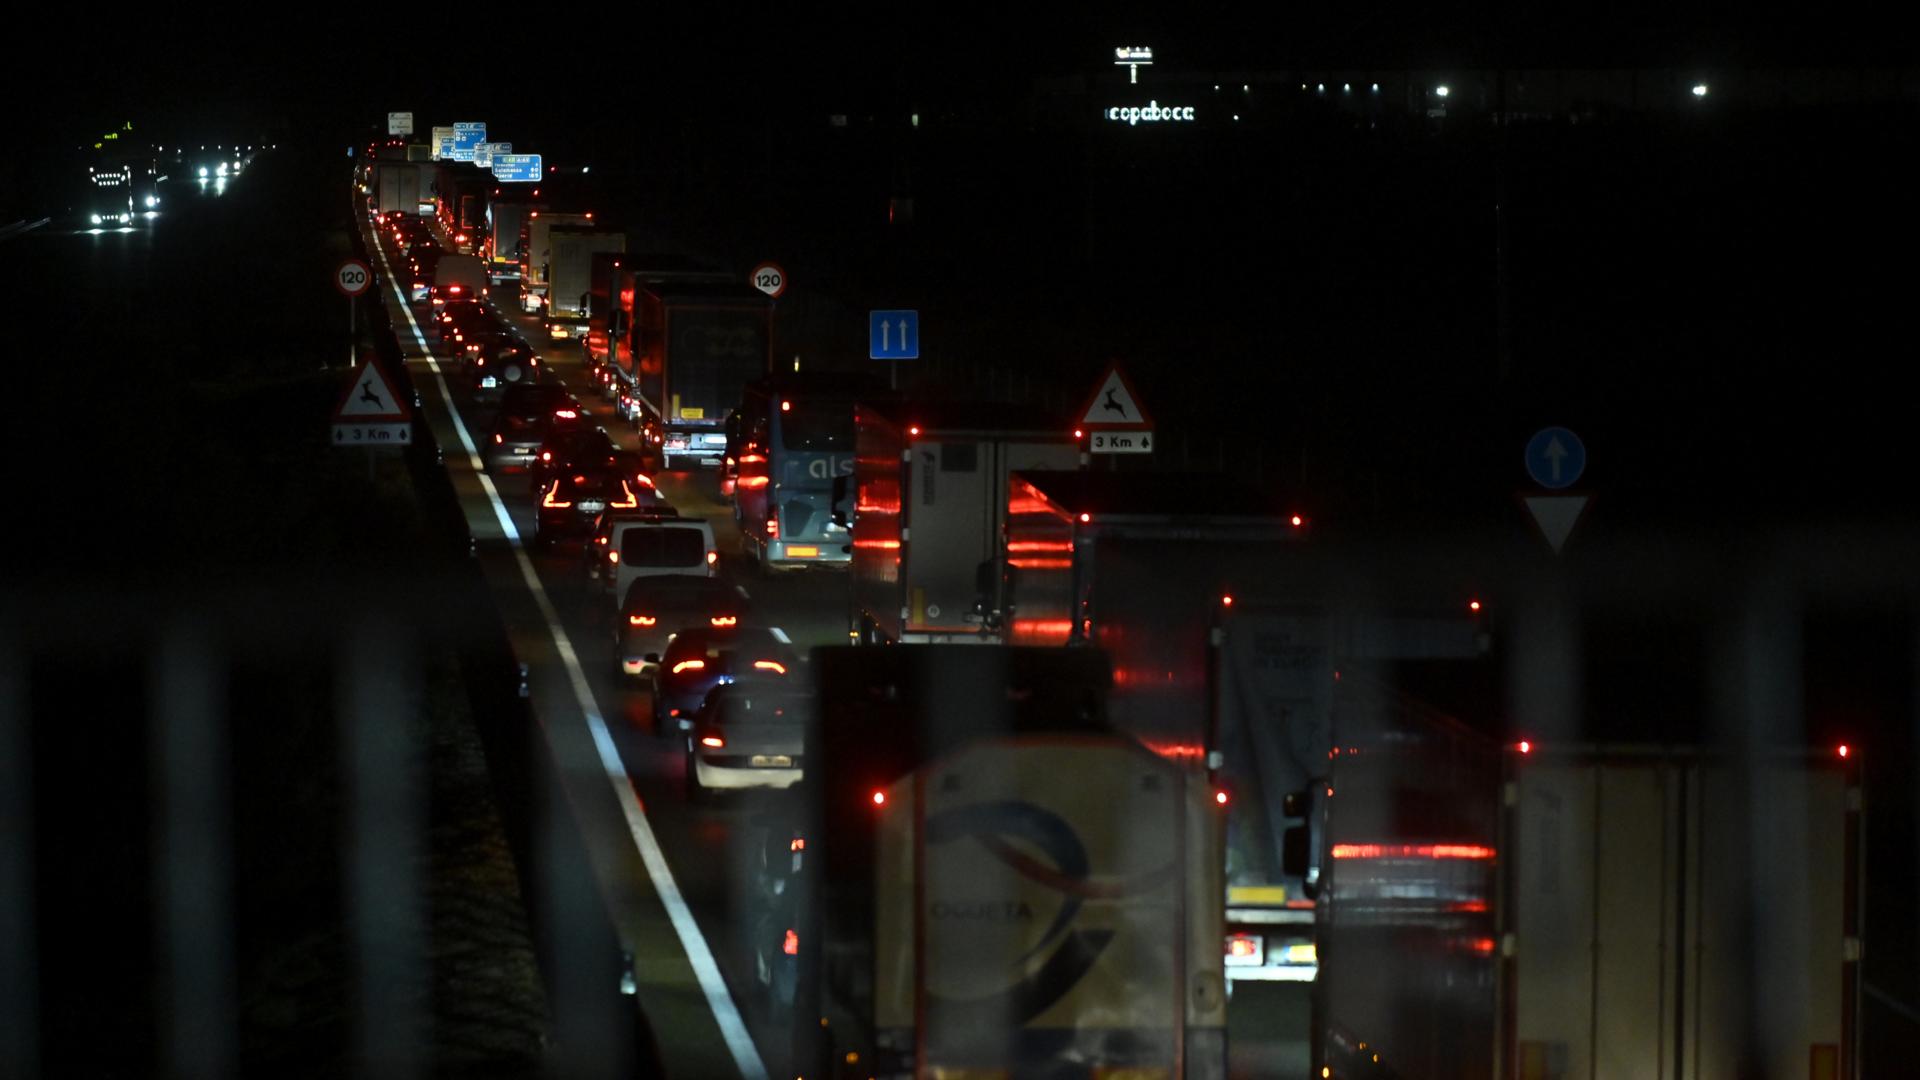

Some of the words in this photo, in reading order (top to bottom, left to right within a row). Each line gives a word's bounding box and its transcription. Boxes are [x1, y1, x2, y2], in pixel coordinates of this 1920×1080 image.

[1109, 100, 1195, 126] copaboca
[341, 271, 365, 284] 120
[756, 274, 780, 287] 120
[353, 429, 361, 440] 3
[368, 429, 390, 440] Km
[1095, 436, 1104, 447] 3
[1110, 436, 1132, 447] Km
